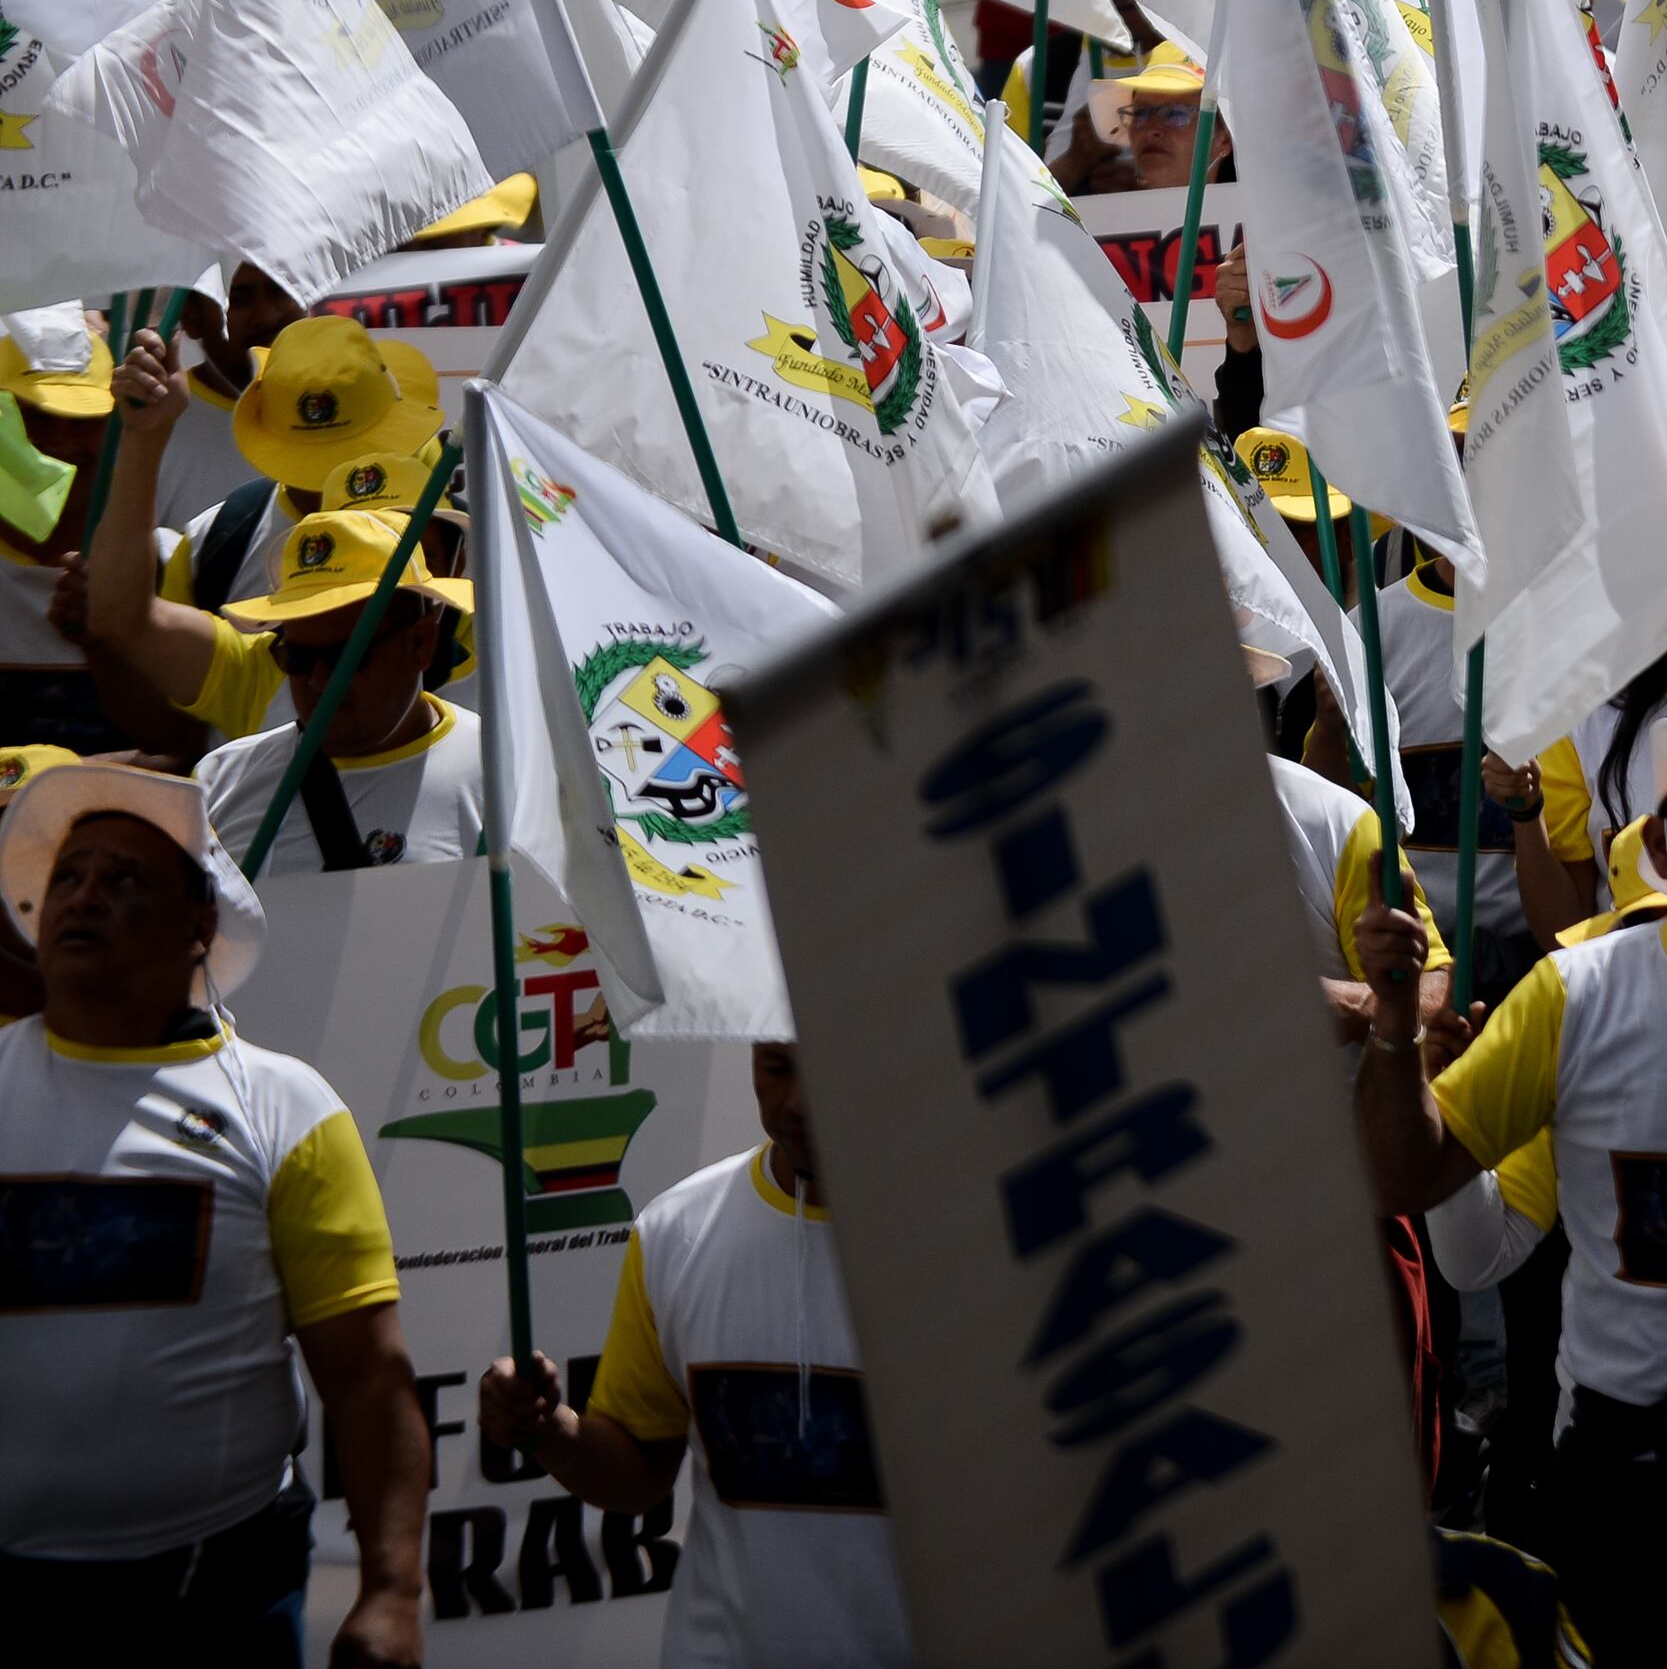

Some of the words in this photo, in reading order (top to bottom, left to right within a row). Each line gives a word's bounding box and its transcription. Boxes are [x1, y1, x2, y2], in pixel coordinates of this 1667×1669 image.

[915, 60, 955, 98] Fundado
[21, 172, 72, 191] D.C.”
[801, 219, 822, 308] HUMILDAD
[777, 352, 844, 387] Fundado
[1122, 318, 1154, 390] HUMILDAD
[918, 337, 938, 431] NESTIDAD
[1611, 369, 1624, 382] Y
[702, 360, 885, 462] “SINTRAUNIOBRAS
[905, 431, 919, 445] Y
[603, 621, 693, 638] TRABAJO
[509, 1239, 566, 1254] neral
[568, 1233, 594, 1248] del
